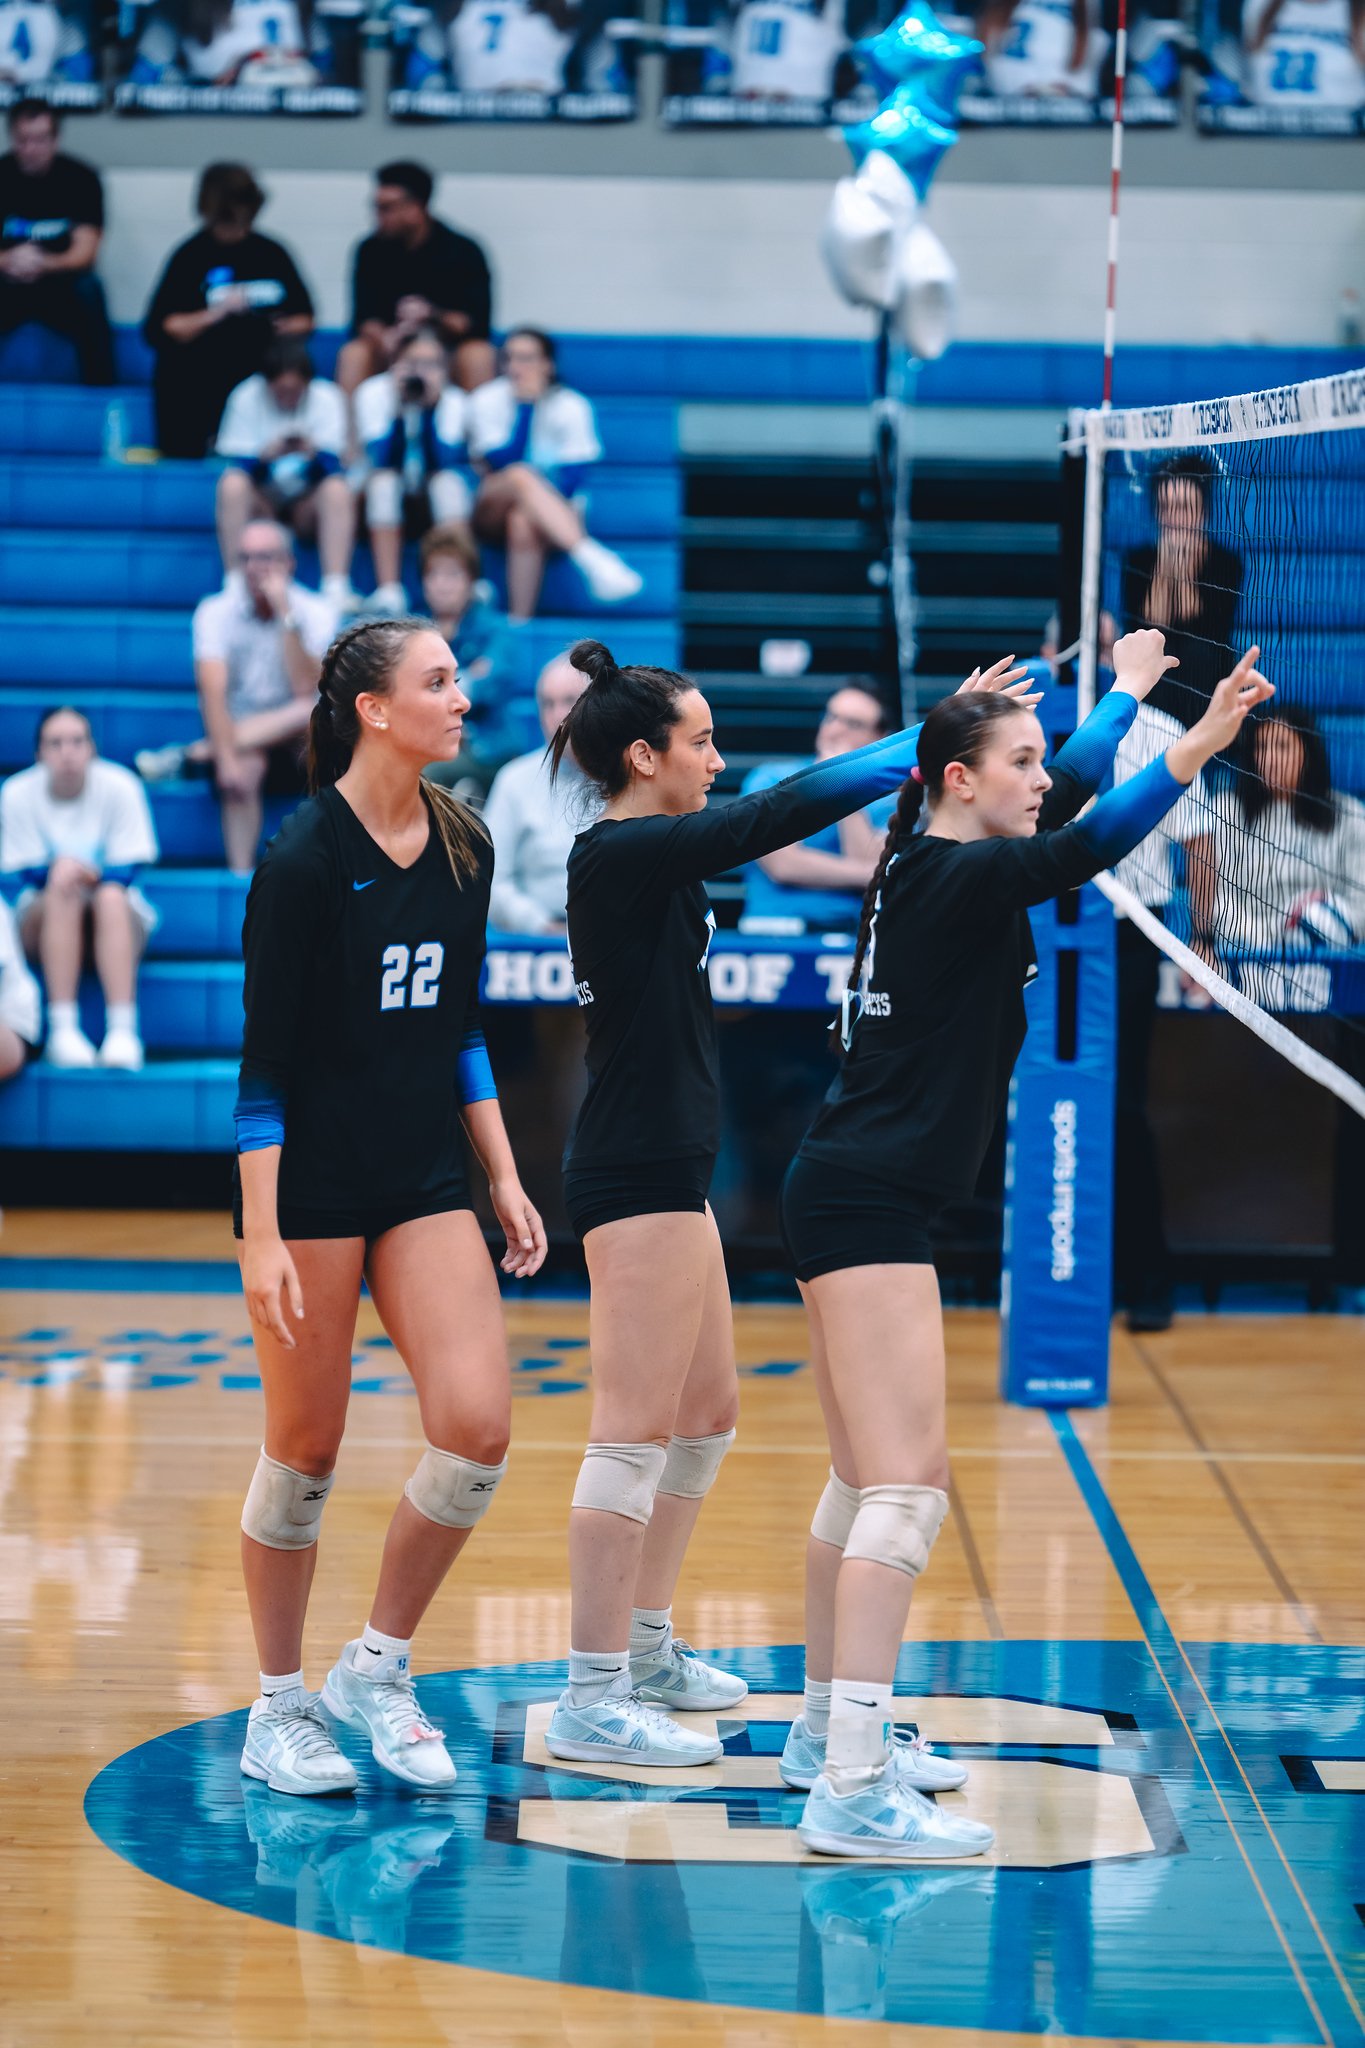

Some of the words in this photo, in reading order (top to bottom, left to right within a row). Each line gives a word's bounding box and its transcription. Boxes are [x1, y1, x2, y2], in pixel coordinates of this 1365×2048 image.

[482, 14, 505, 53] 7
[380, 940, 445, 1013] 22
[485, 950, 574, 1001] HO
[707, 953, 795, 1003] OF
